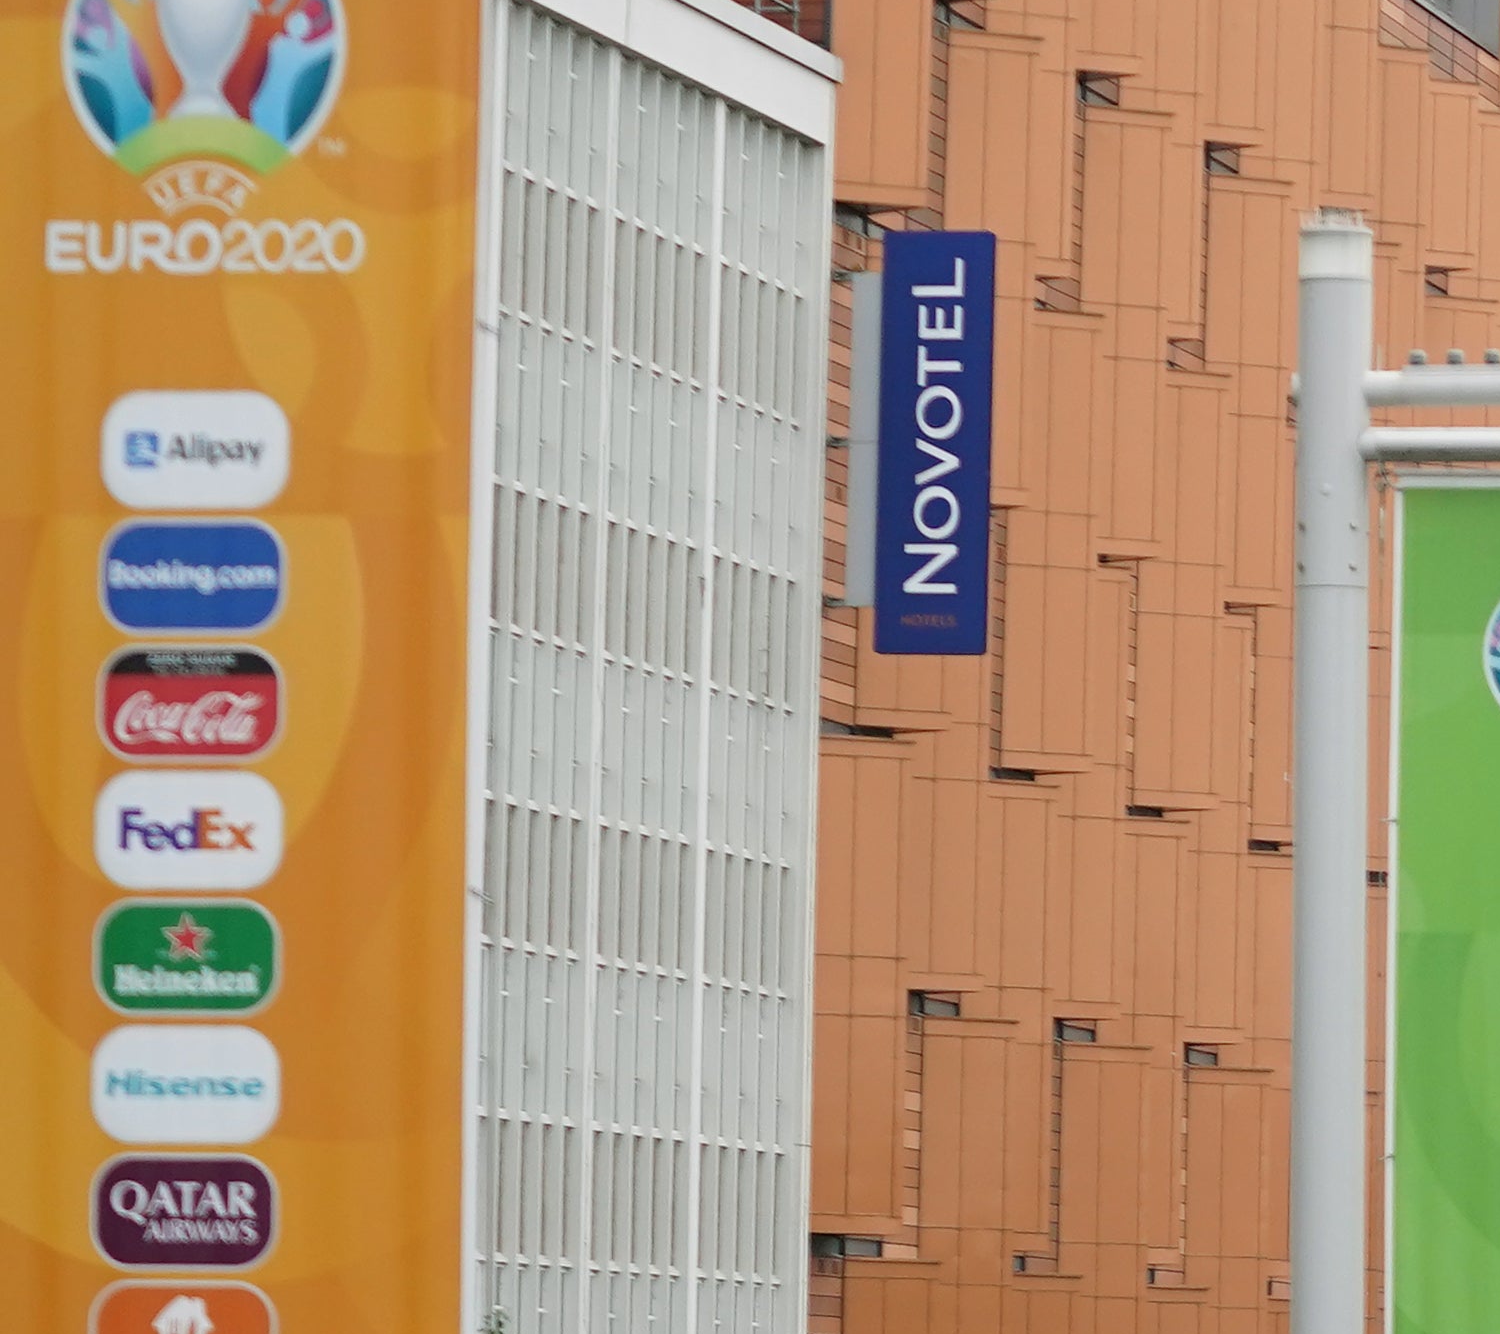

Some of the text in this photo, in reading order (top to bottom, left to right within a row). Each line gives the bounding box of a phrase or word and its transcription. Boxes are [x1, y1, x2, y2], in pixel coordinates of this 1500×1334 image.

[148, 167, 250, 212] UEFA
[44, 218, 366, 273] EURO2020
[903, 257, 966, 594] NOVOTEL
[168, 433, 264, 468] Alipay
[107, 558, 278, 592] Booking.com
[114, 691, 260, 744] Coca-Cola
[118, 807, 256, 851] FedEx
[114, 964, 259, 996] Heineken
[106, 1071, 265, 1098] Hisense
[110, 1179, 257, 1225] QATAR
[144, 1219, 259, 1244] AIRWAYS
